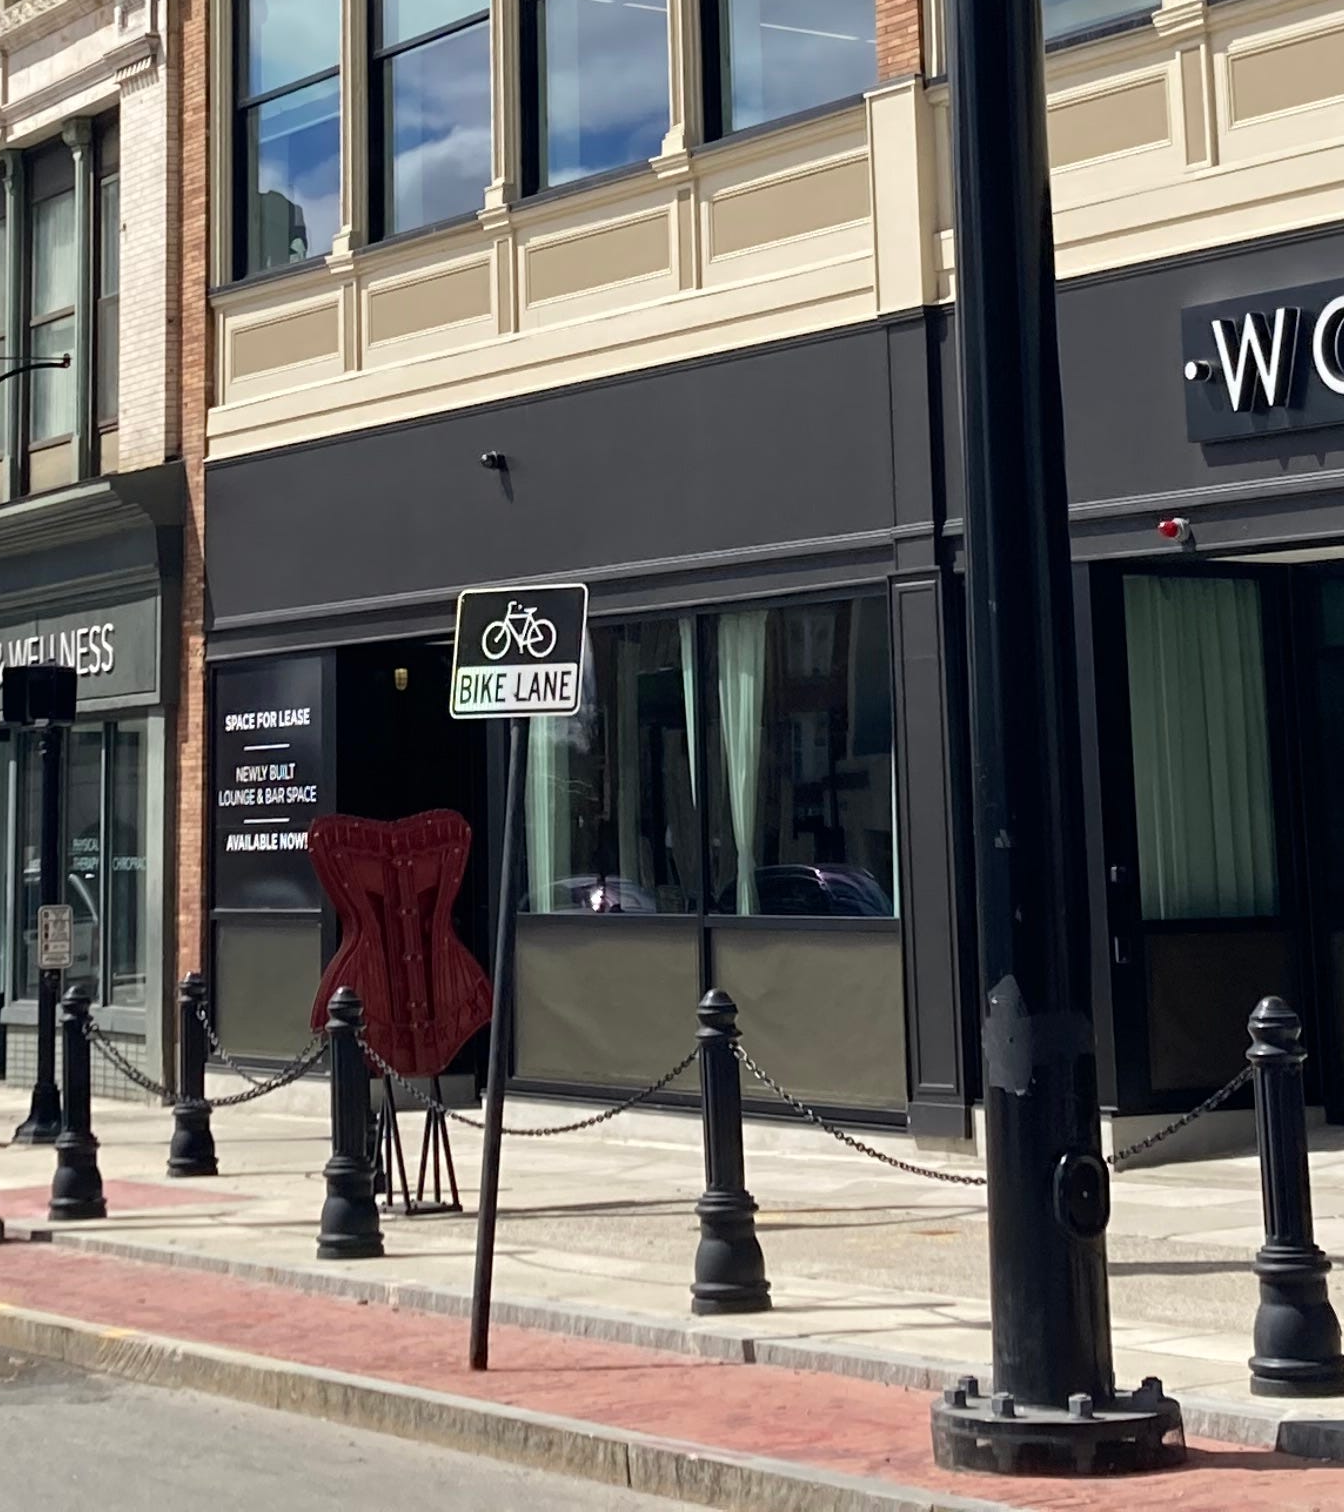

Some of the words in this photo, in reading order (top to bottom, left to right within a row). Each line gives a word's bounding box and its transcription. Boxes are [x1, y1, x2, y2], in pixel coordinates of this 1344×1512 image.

[460, 672, 507, 704] BIKE
[515, 670, 572, 702] LANE
[225, 712, 255, 732] SPACE
[257, 710, 277, 730] FOR
[279, 708, 311, 727] LEASE
[235, 765, 268, 783] NEWLY
[270, 763, 295, 781] BUILT
[218, 789, 256, 806] LOUNGE
[257, 788, 264, 804] &
[265, 787, 285, 804] BAR
[286, 786, 317, 804] SPACE
[226, 833, 278, 852] AVAILABLE
[279, 831, 308, 850] NOW!
